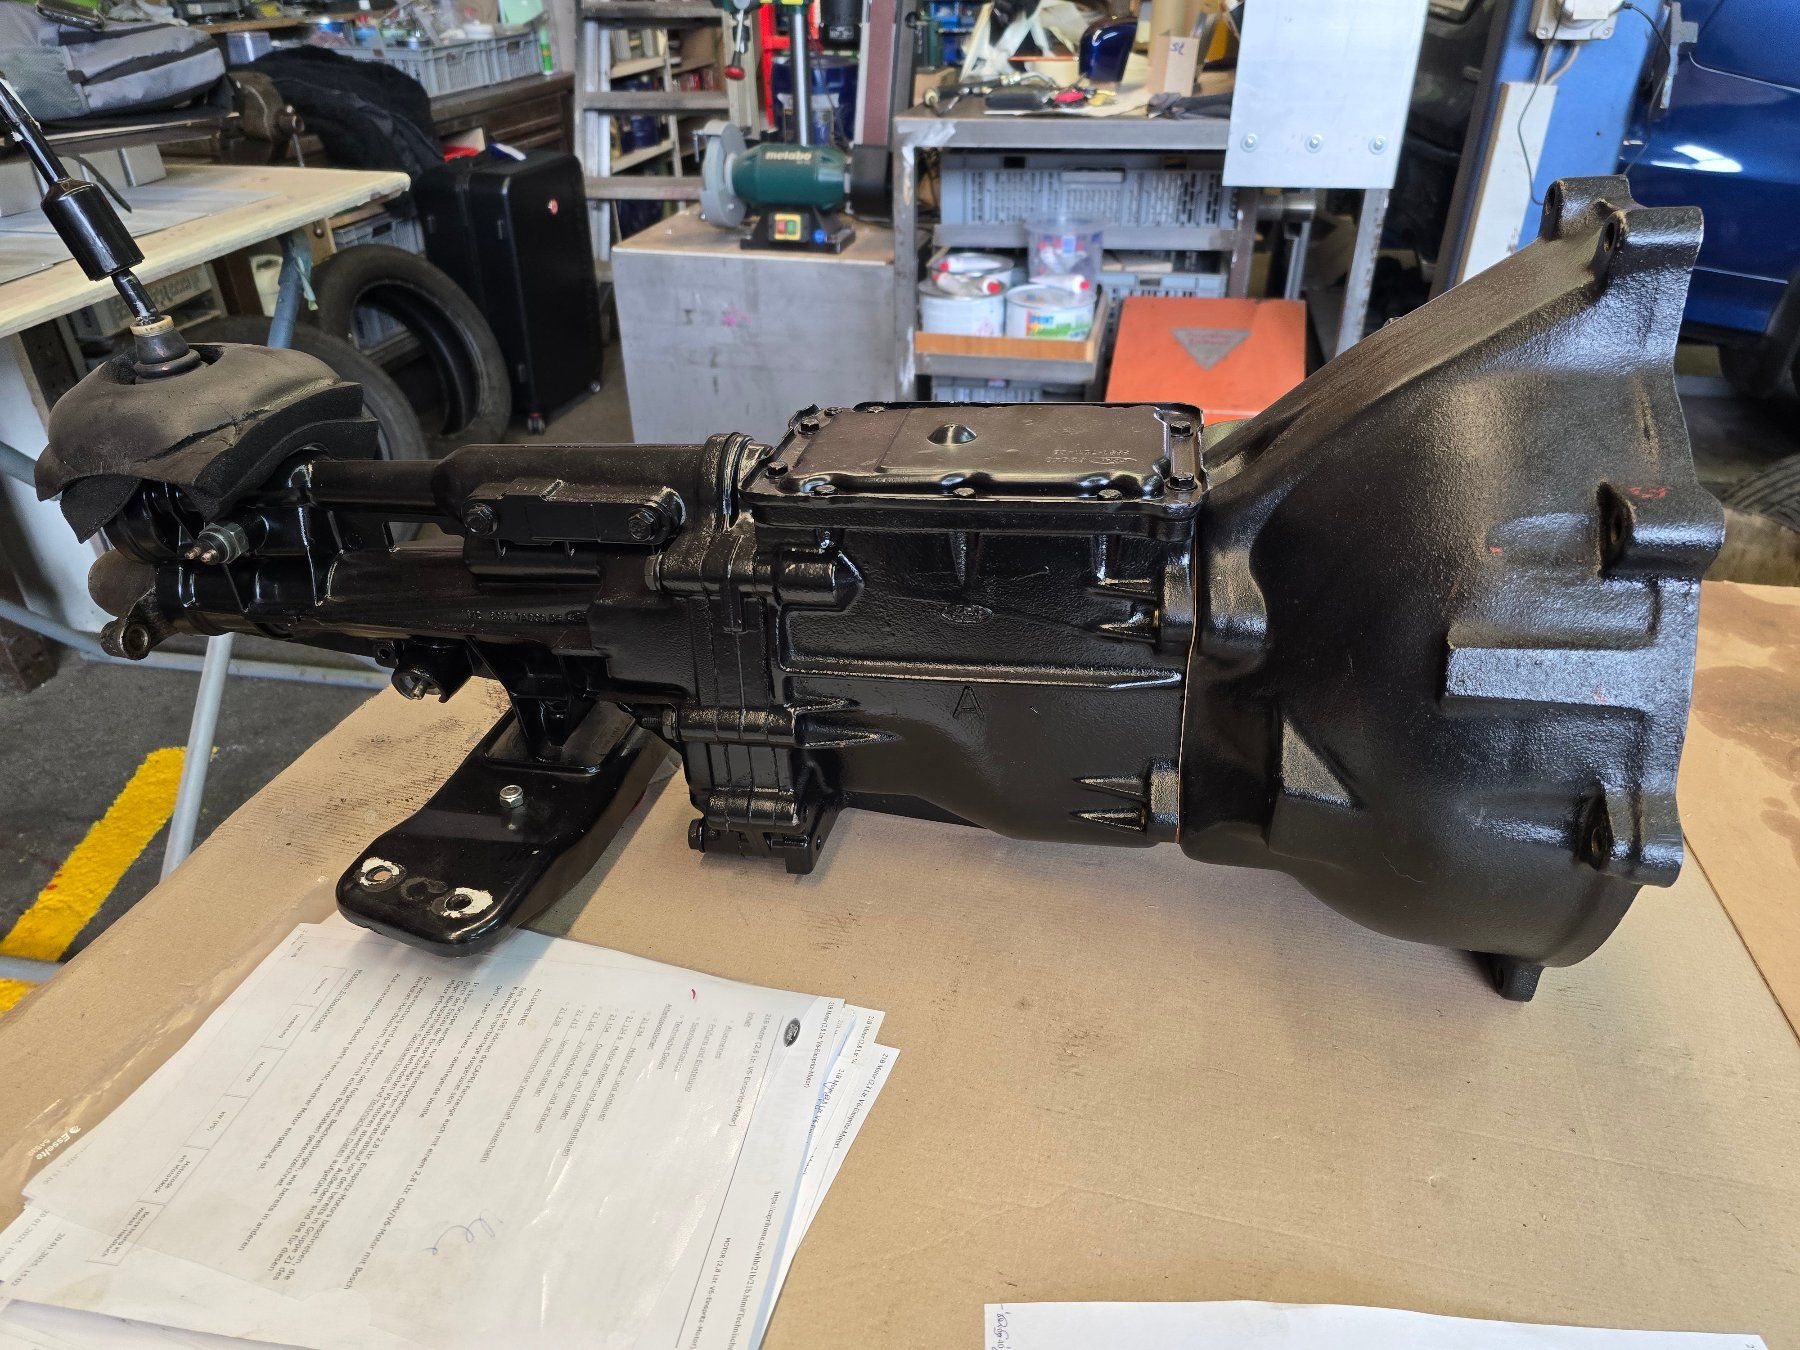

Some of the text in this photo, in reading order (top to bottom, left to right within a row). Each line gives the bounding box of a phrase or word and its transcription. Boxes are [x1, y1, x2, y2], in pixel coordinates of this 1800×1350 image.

[765, 151, 811, 161] metabo
[952, 685, 985, 719] A
[288, 1107, 307, 1126] Motor
[312, 1097, 342, 1134] Buchstaben
[437, 1118, 451, 1134] auch
[36, 1132, 71, 1160] Esselte
[293, 1118, 337, 1172] Beschreibungen,
[285, 1174, 299, 1186] wie
[314, 1167, 344, 1203] Außerdem
[323, 1162, 367, 1218] Einspritz-Motors
[334, 1176, 348, 1189] den
[266, 1187, 289, 1212] bereits
[303, 1204, 319, 1219] sind
[316, 1191, 339, 1216] bereits
[294, 1221, 308, 1233] die
[365, 1196, 405, 1250] OHV/V6-Motor
[237, 1221, 264, 1251] anderen
[285, 1234, 299, 1245] für
[289, 1225, 315, 1253] Gruppe
[291, 1219, 330, 1267] beschrieben,
[718, 1236, 732, 1259] MOTOR
[267, 1247, 290, 1271] diesen
[283, 1255, 295, 1264] 21
[358, 1251, 373, 1265] mit
[272, 1267, 287, 1281] des
[283, 1268, 298, 1281] die
[343, 1266, 363, 1290] Bosch
